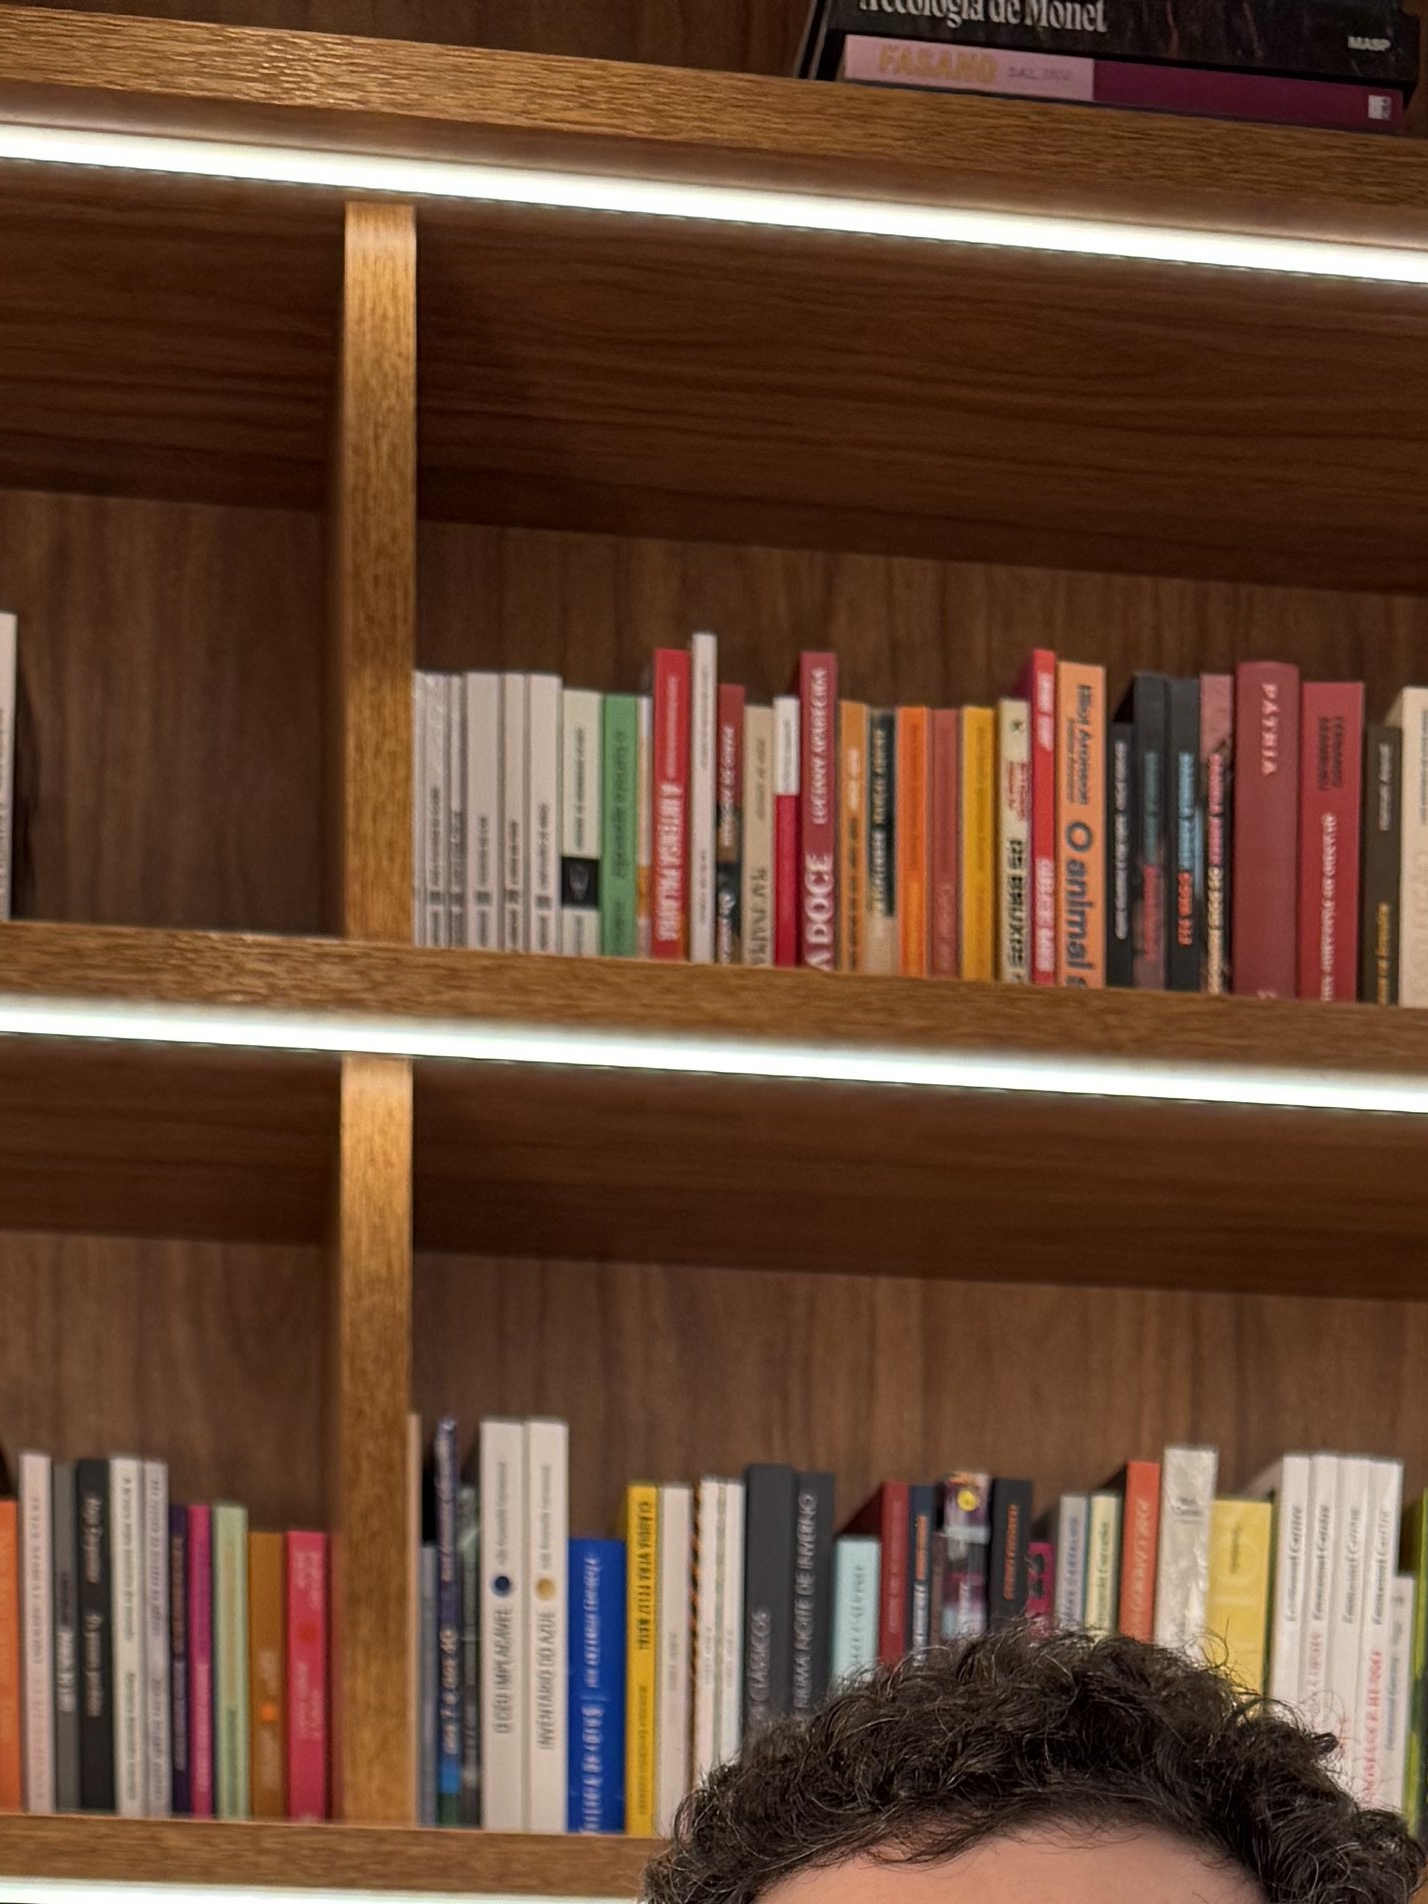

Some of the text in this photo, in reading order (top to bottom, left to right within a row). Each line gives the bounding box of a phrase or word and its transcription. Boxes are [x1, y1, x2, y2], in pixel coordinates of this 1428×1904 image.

[877, 44, 1000, 85] FASANO
[1348, 35, 1390, 53] MASP
[1260, 683, 1281, 776] PÁTRIA
[805, 854, 834, 944] DOCE
[1065, 821, 1096, 970] O animal
